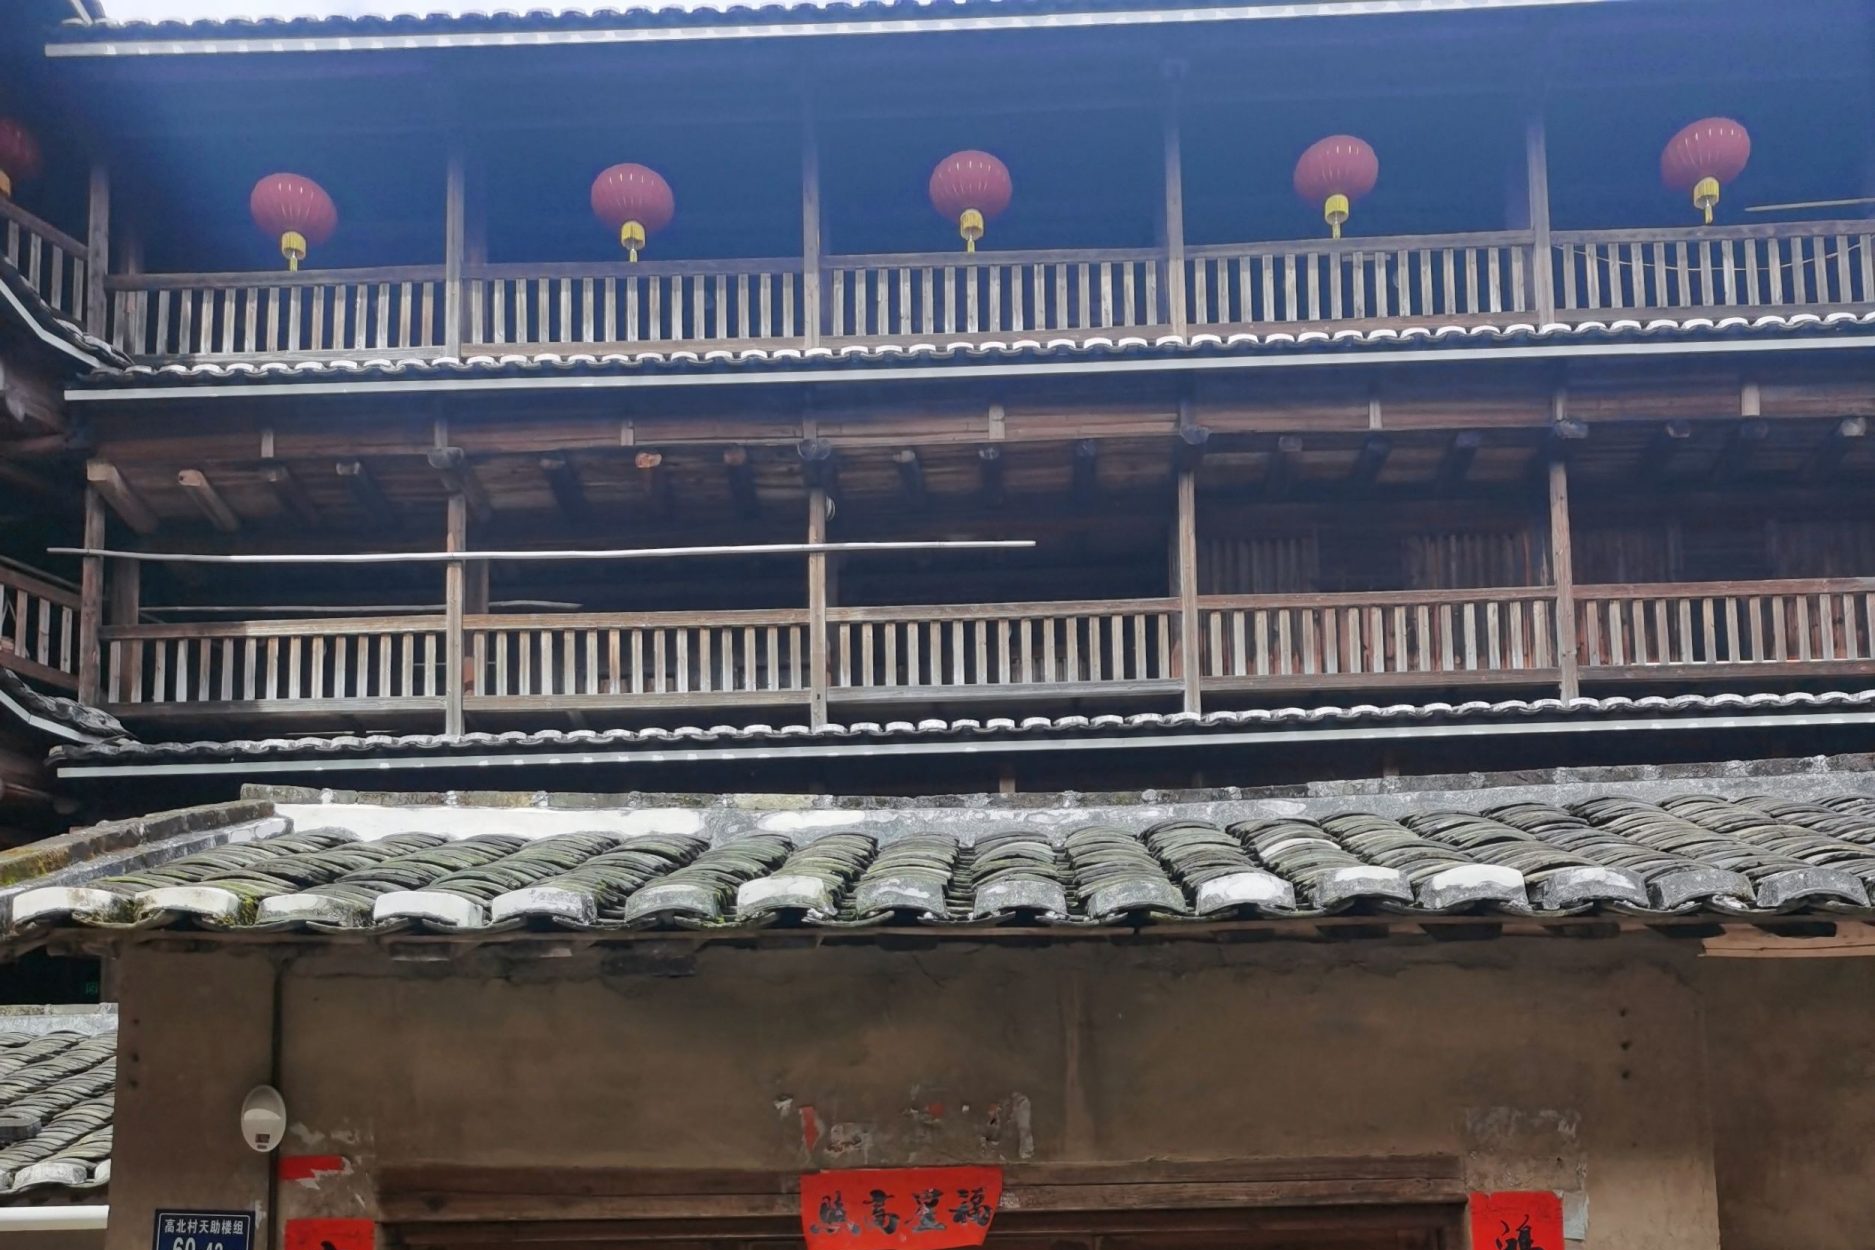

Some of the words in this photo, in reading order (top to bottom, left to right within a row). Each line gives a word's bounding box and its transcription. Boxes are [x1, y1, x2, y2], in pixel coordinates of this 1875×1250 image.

[164, 1218, 244, 1235] 高北村天助楼组
